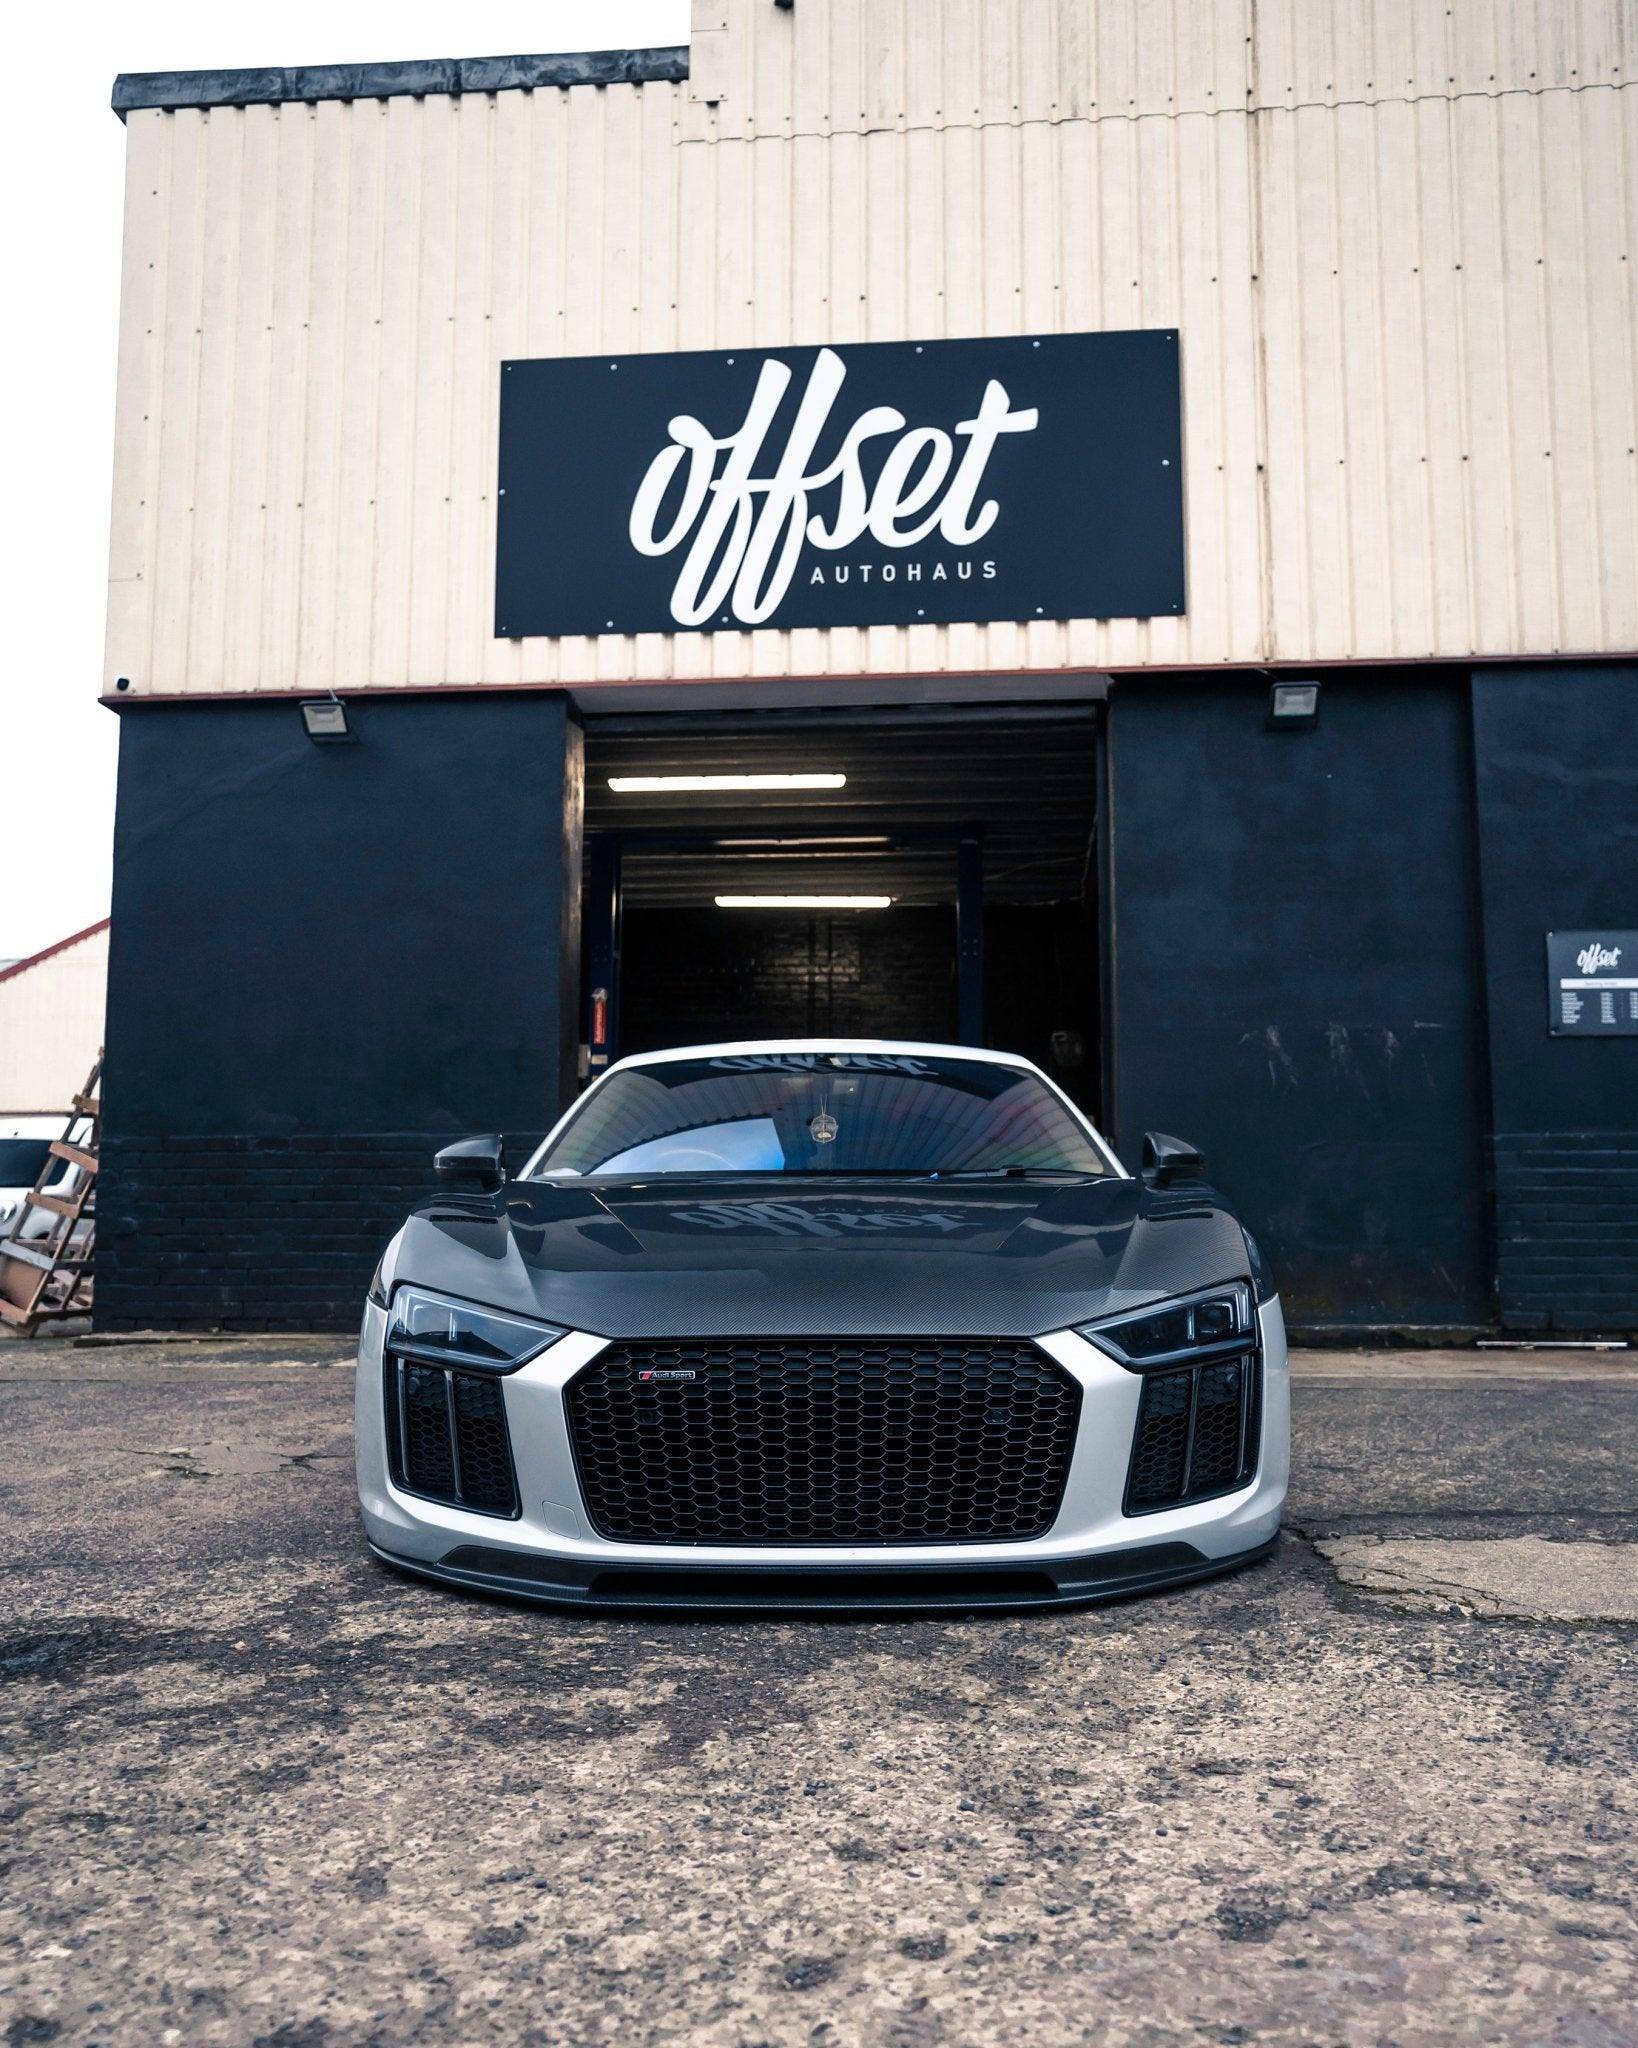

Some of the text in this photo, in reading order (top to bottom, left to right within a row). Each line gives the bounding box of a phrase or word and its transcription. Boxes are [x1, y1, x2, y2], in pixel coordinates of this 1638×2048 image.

[629, 347, 1039, 626] offset
[810, 560, 997, 585] AUTOHAUS
[1577, 942, 1622, 974] offset
[670, 1371, 693, 1380] Sport
